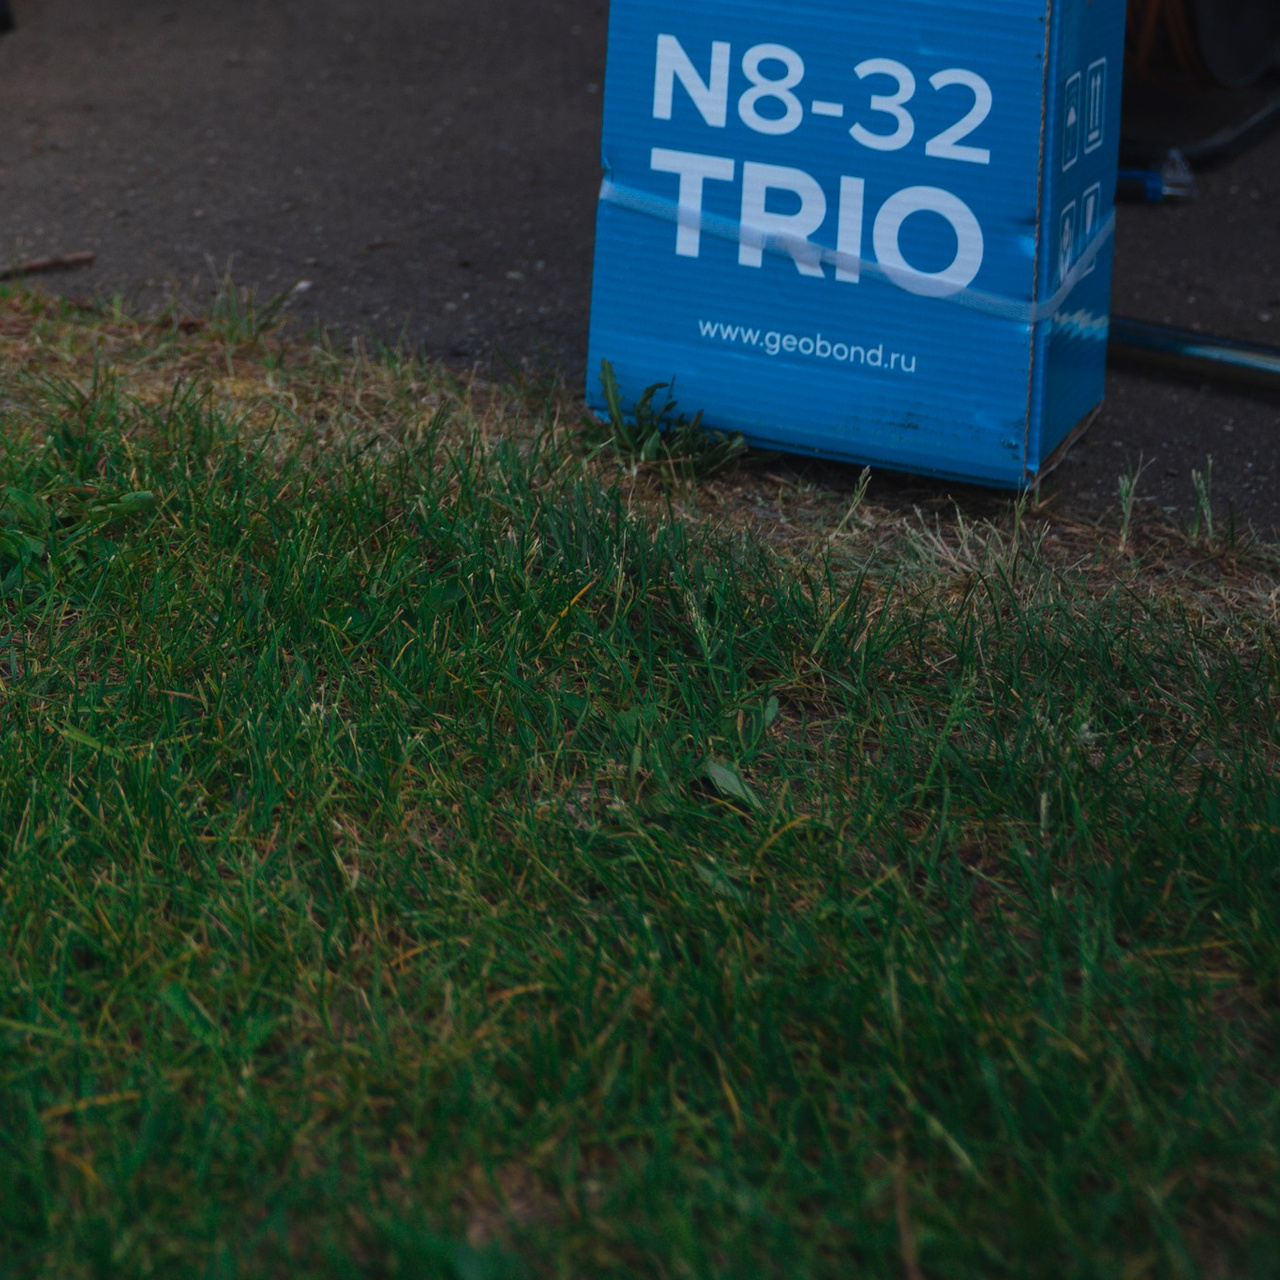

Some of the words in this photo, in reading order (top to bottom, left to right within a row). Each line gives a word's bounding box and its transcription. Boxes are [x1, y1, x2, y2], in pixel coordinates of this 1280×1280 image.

[651, 33, 994, 165] N8-32
[649, 147, 984, 298] TRIO
[698, 318, 917, 374] www.geobond.ru
